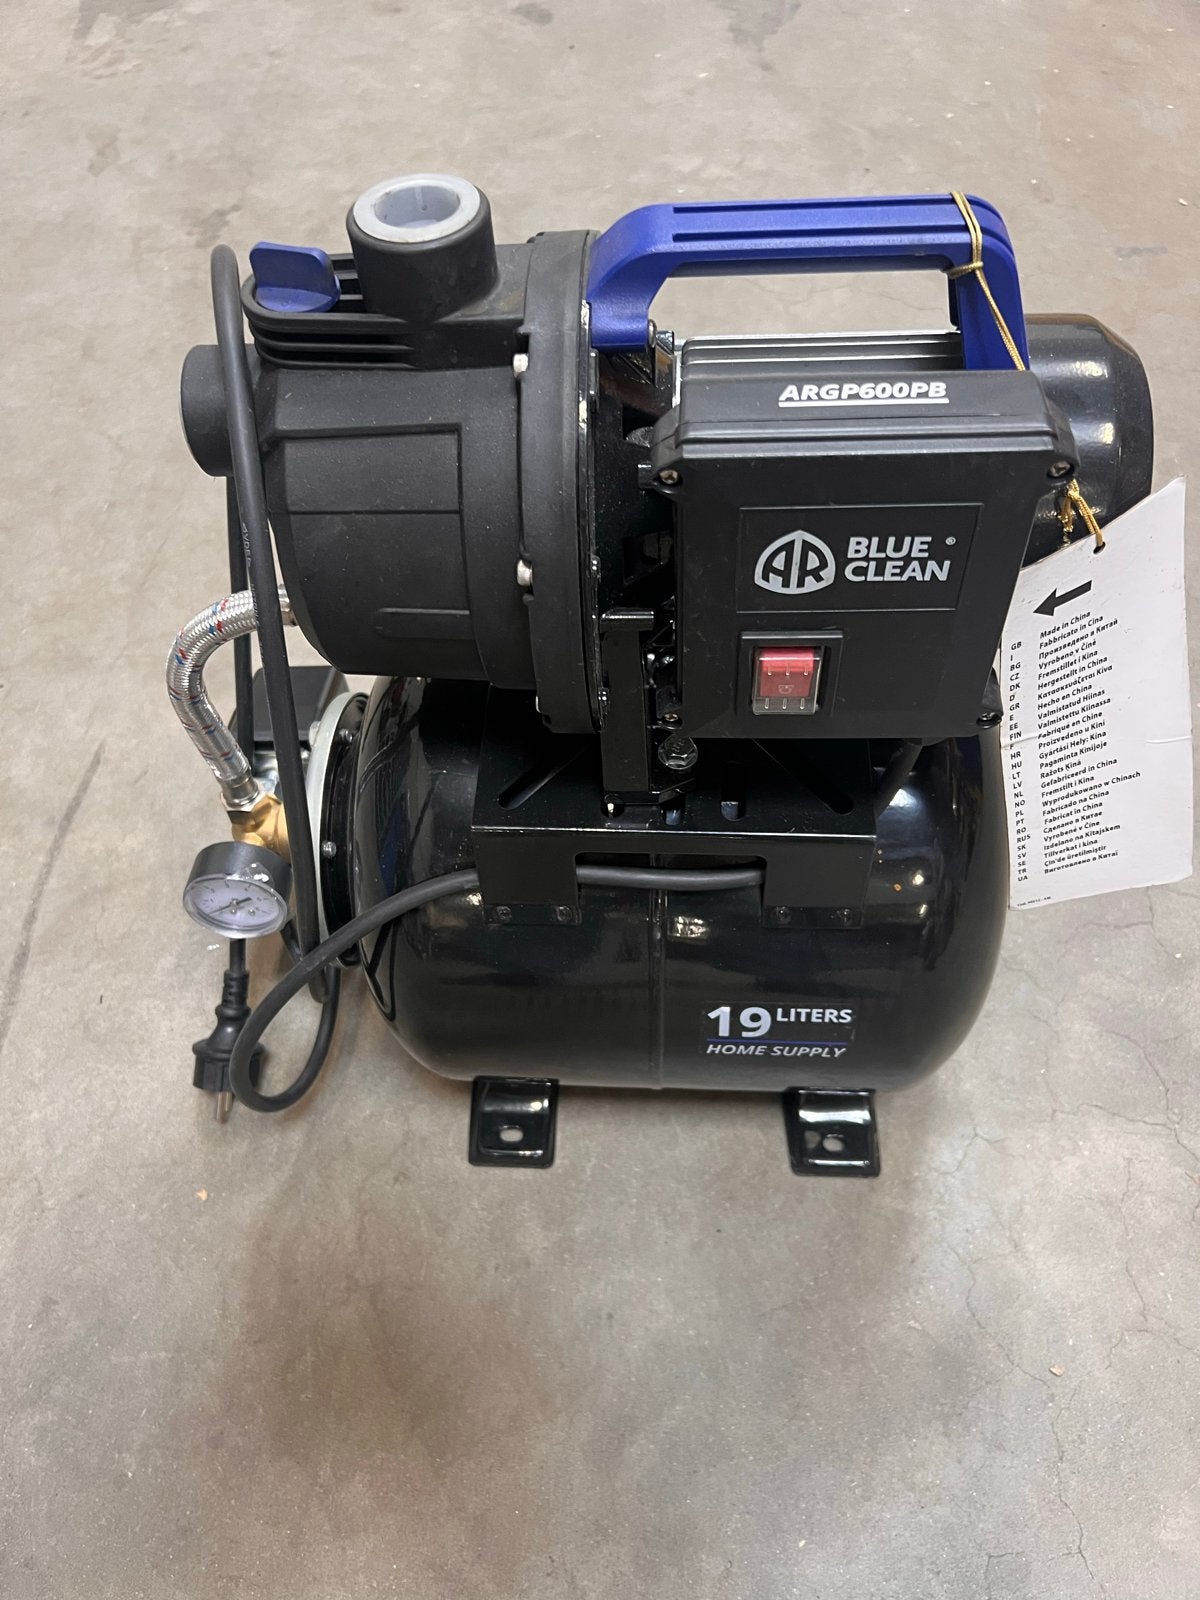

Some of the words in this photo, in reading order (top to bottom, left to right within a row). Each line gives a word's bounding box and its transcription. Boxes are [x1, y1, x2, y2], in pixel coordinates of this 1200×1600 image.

[779, 381, 948, 402] ARGP600PB
[847, 536, 932, 559] BLUE
[844, 560, 950, 582] CLEAN
[1040, 626, 1060, 639] Made
[1062, 622, 1068, 630] in
[1070, 612, 1091, 625] China
[1040, 629, 1078, 649] Fabbricato
[1088, 616, 1103, 627] Cina
[1011, 641, 1022, 651] GB
[1010, 662, 1021, 672] BG
[1038, 658, 1077, 680] Fremstillet
[1082, 650, 1098, 660] Kina
[1039, 651, 1073, 670] Vyrobeno
[1010, 673, 1020, 681] CZ
[1038, 669, 1078, 690] Hergestellt
[1087, 657, 1107, 669] China
[1010, 682, 1021, 692] DK
[1010, 694, 1015, 702] D
[1038, 696, 1060, 710] Hecho
[1072, 684, 1092, 696] China
[1010, 703, 1020, 711] GR
[1038, 699, 1081, 720] Valmistatud
[1083, 689, 1105, 701] Hiinas
[1038, 710, 1080, 730] Valmistettu
[1081, 698, 1111, 713] Kiinassa
[1082, 712, 1102, 723] Chine
[1010, 723, 1018, 731] EE
[1039, 729, 1083, 749] Proizvedeno
[1091, 719, 1106, 730] Kini
[1010, 731, 1022, 741] FIN
[1010, 751, 1021, 760] HR
[1040, 751, 1078, 769] Pagaminta
[1011, 762, 1022, 770] HU
[1041, 768, 1086, 788] Gefabriceerd
[1096, 758, 1118, 769] China
[1012, 772, 1020, 780] LT
[1013, 781, 1022, 789] LV
[1042, 782, 1073, 798] Fremstilt
[1078, 776, 1094, 785] Kina
[1042, 784, 1102, 808] Wyprodukowano
[1111, 772, 1141, 784] Chinach
[1015, 800, 1025, 808] NO
[1042, 800, 1077, 816] Fabricado
[1089, 790, 1109, 800] China
[1044, 810, 1073, 824] Fabricat
[1082, 802, 1103, 811] China
[1016, 818, 1024, 826] PT
[1016, 827, 1026, 835] RO
[1085, 825, 1120, 837] Kitajskem
[1017, 834, 1031, 843] RUS
[1044, 845, 1077, 858] Tillverkat
[707, 1006, 772, 1038] 19
[776, 1008, 852, 1023] LITERS
[706, 1044, 766, 1056] HOME
[770, 1046, 846, 1058] SUPPLY
